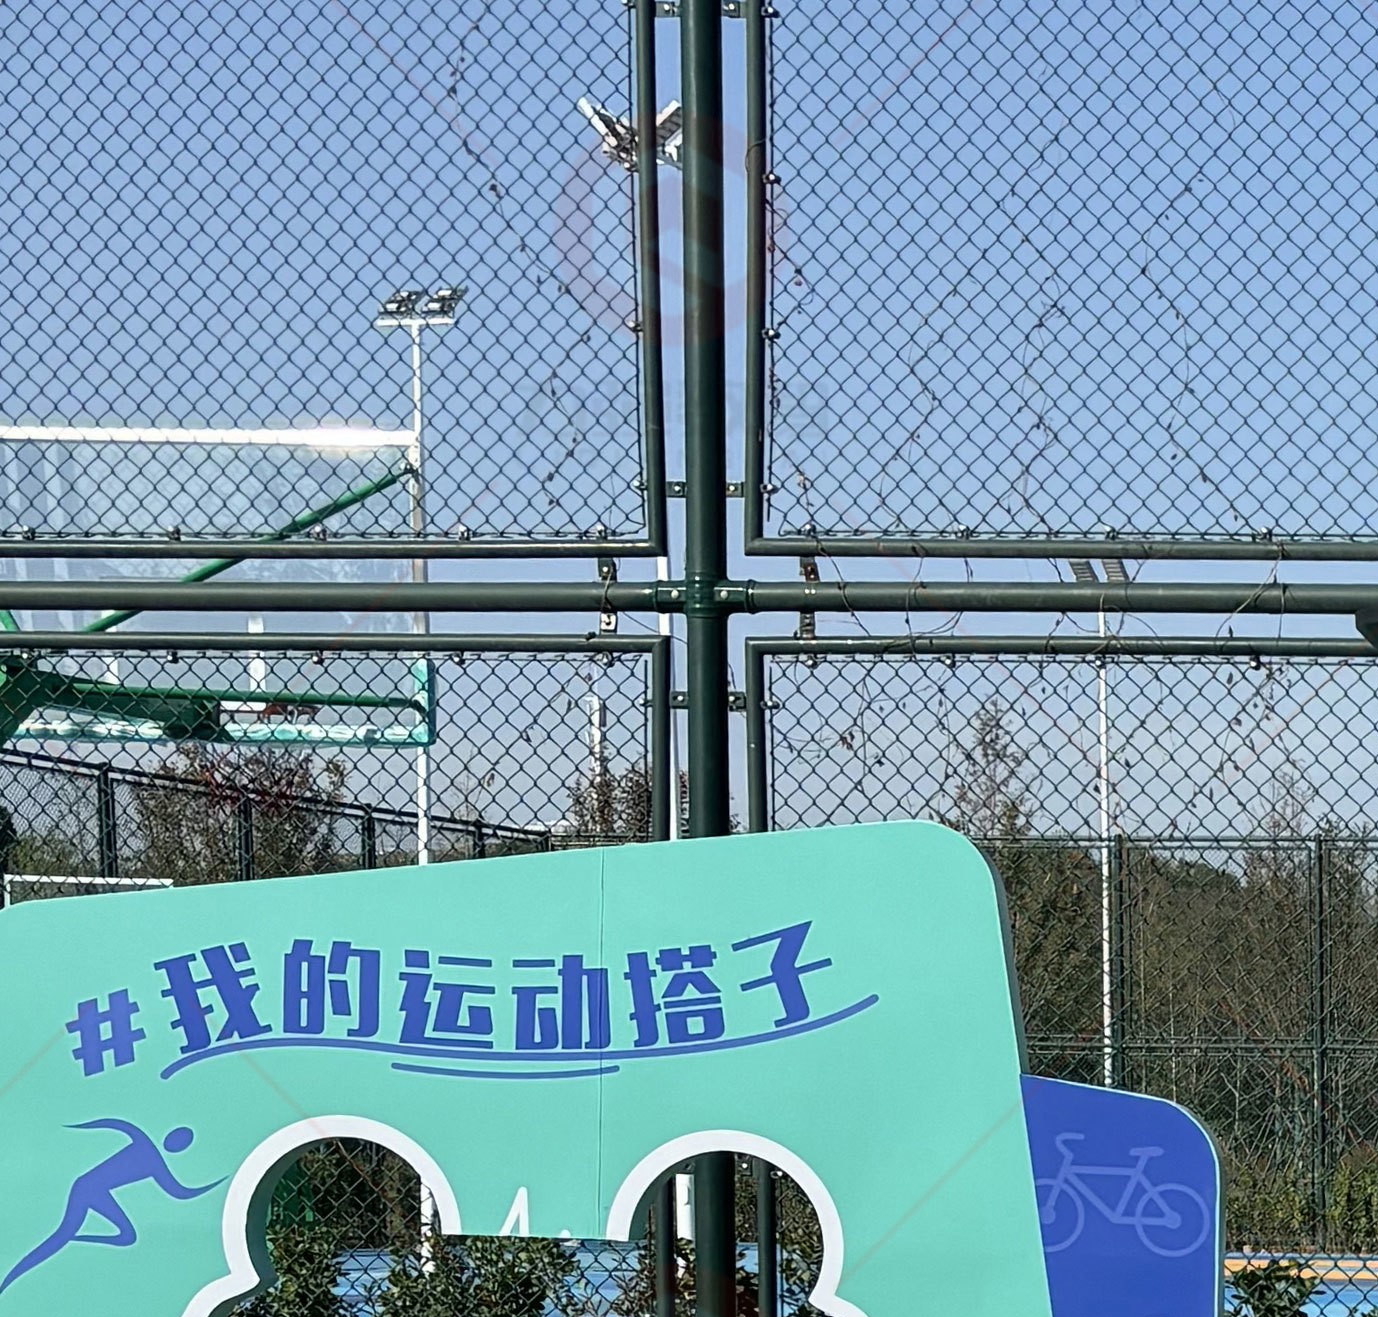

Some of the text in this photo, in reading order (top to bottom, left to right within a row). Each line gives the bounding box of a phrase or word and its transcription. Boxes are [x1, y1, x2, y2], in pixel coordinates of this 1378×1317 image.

[65, 920, 833, 1077] #我的运动搭子
